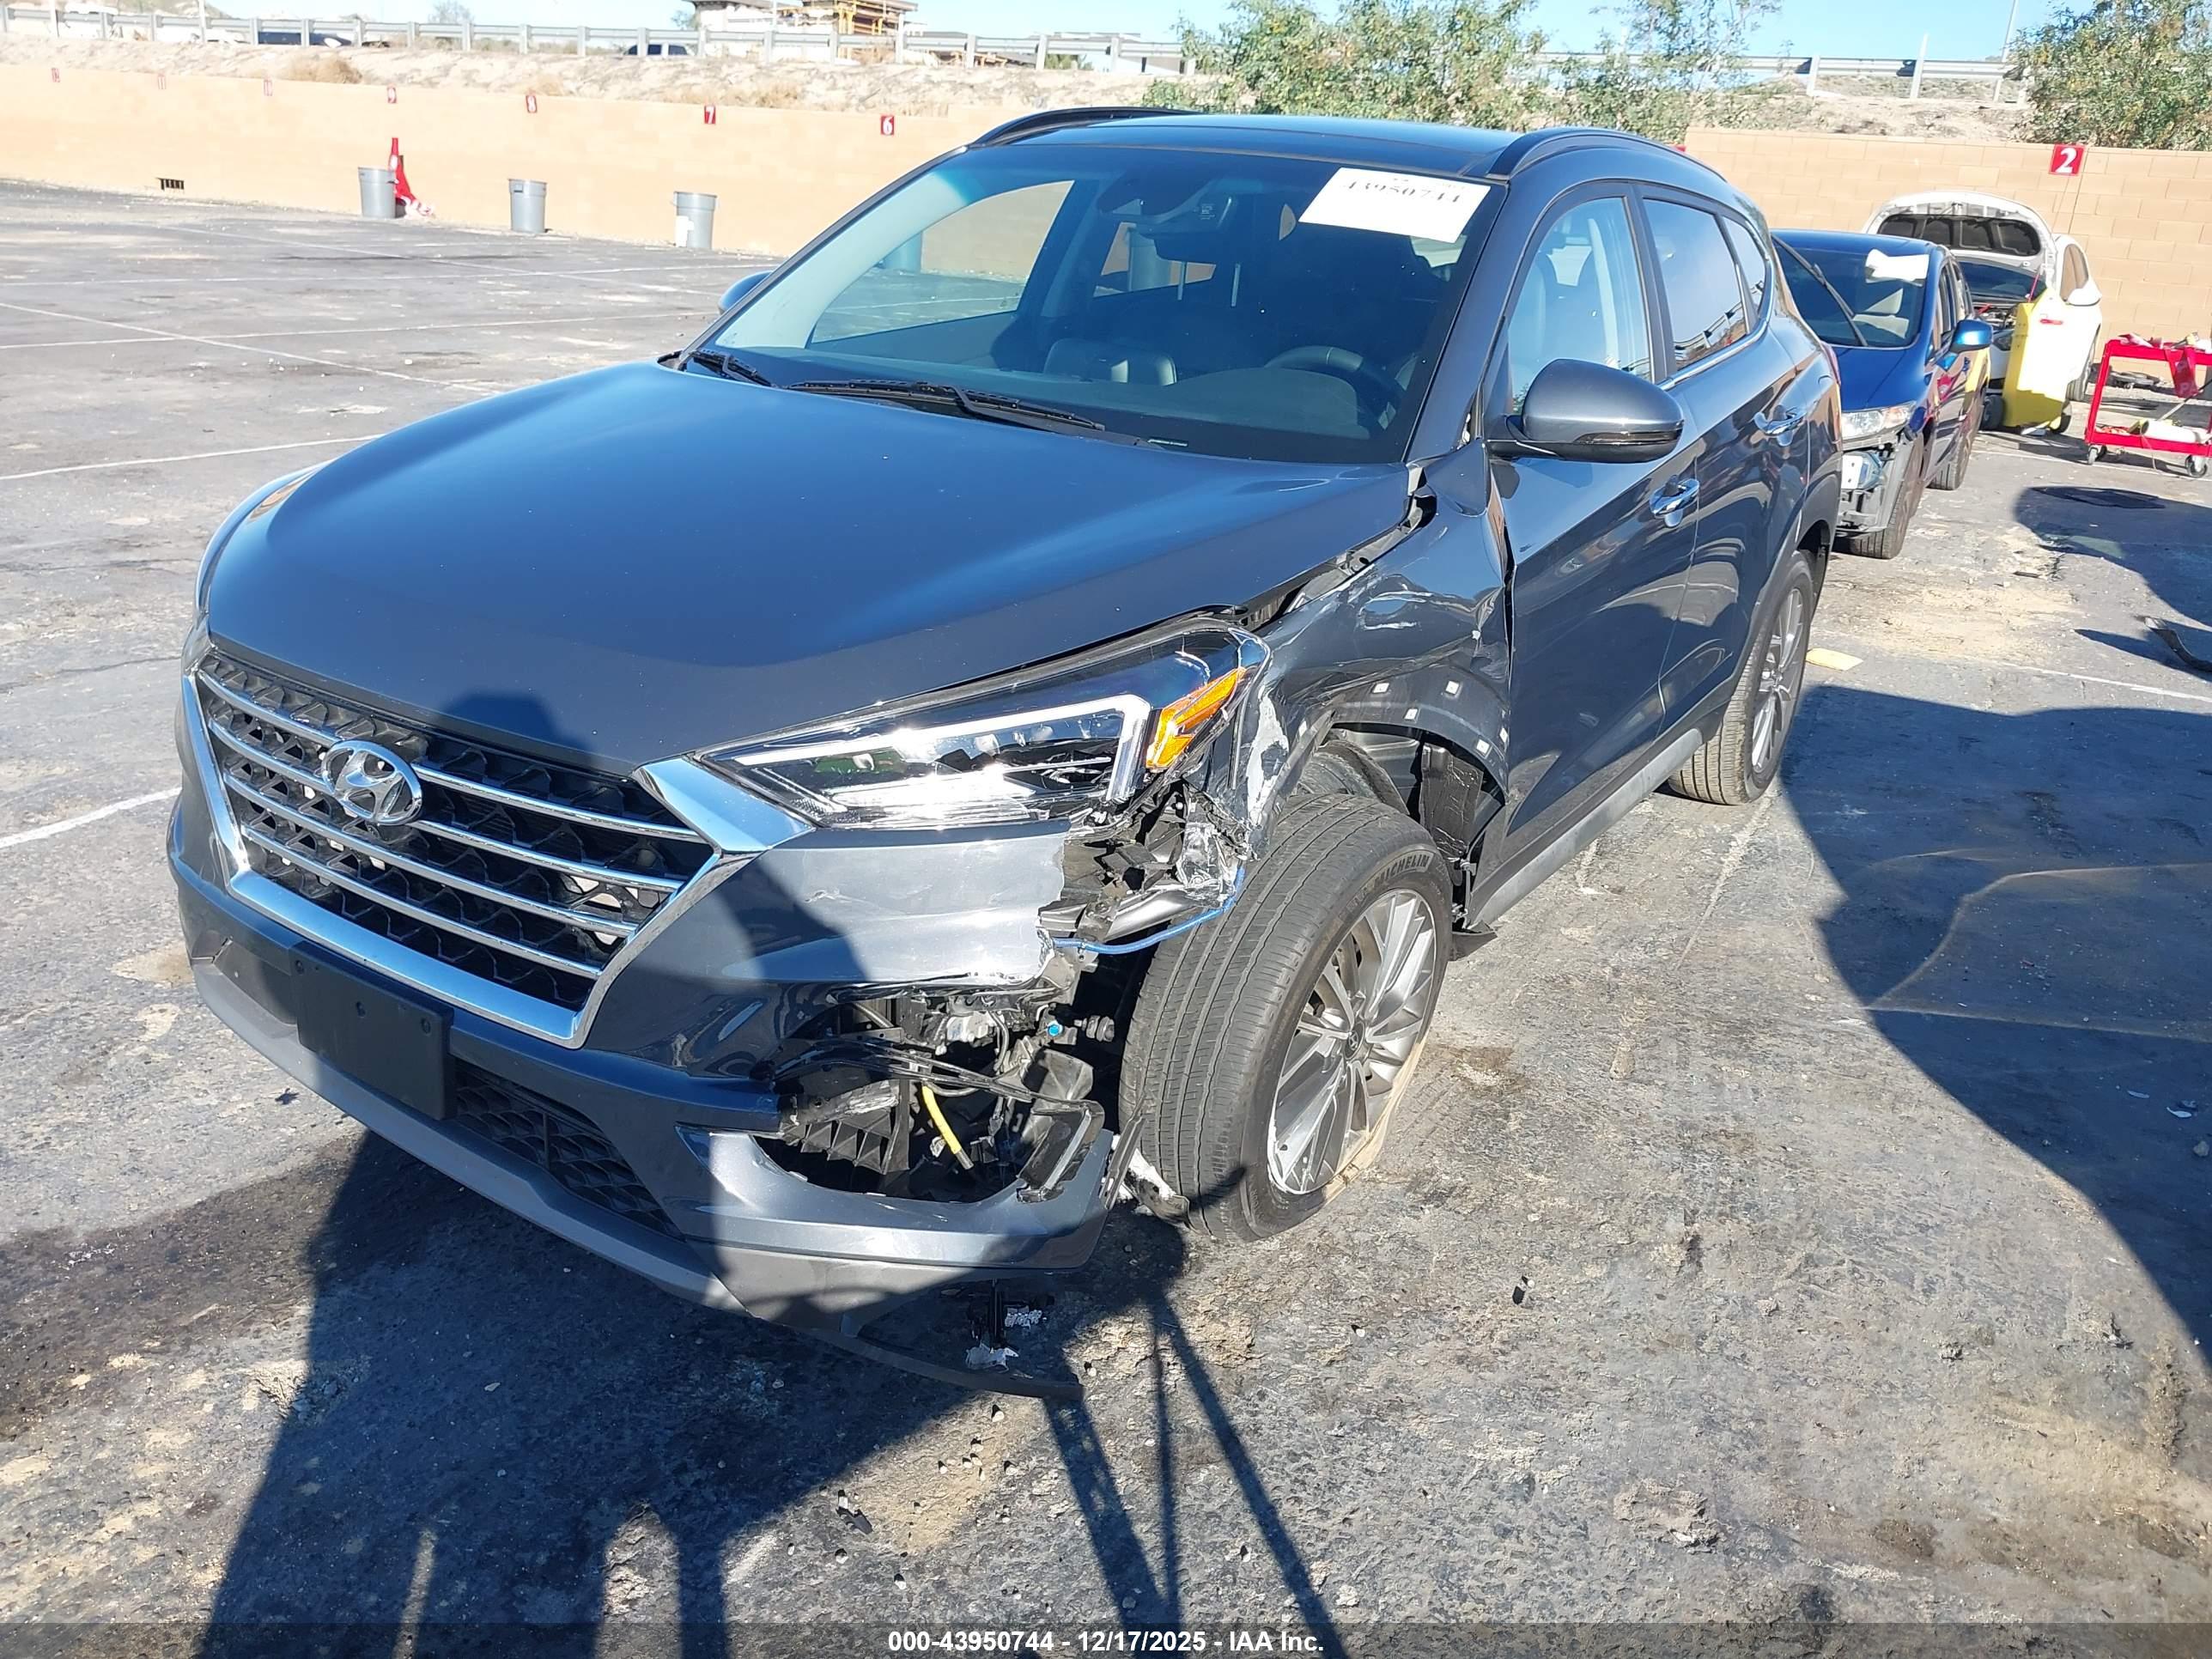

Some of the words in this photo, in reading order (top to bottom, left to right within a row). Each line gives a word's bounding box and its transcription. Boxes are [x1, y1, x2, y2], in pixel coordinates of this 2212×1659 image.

[526, 94, 537, 112] 8
[705, 106, 715, 124] 7
[883, 116, 894, 136] 6
[2055, 147, 2077, 173] 2
